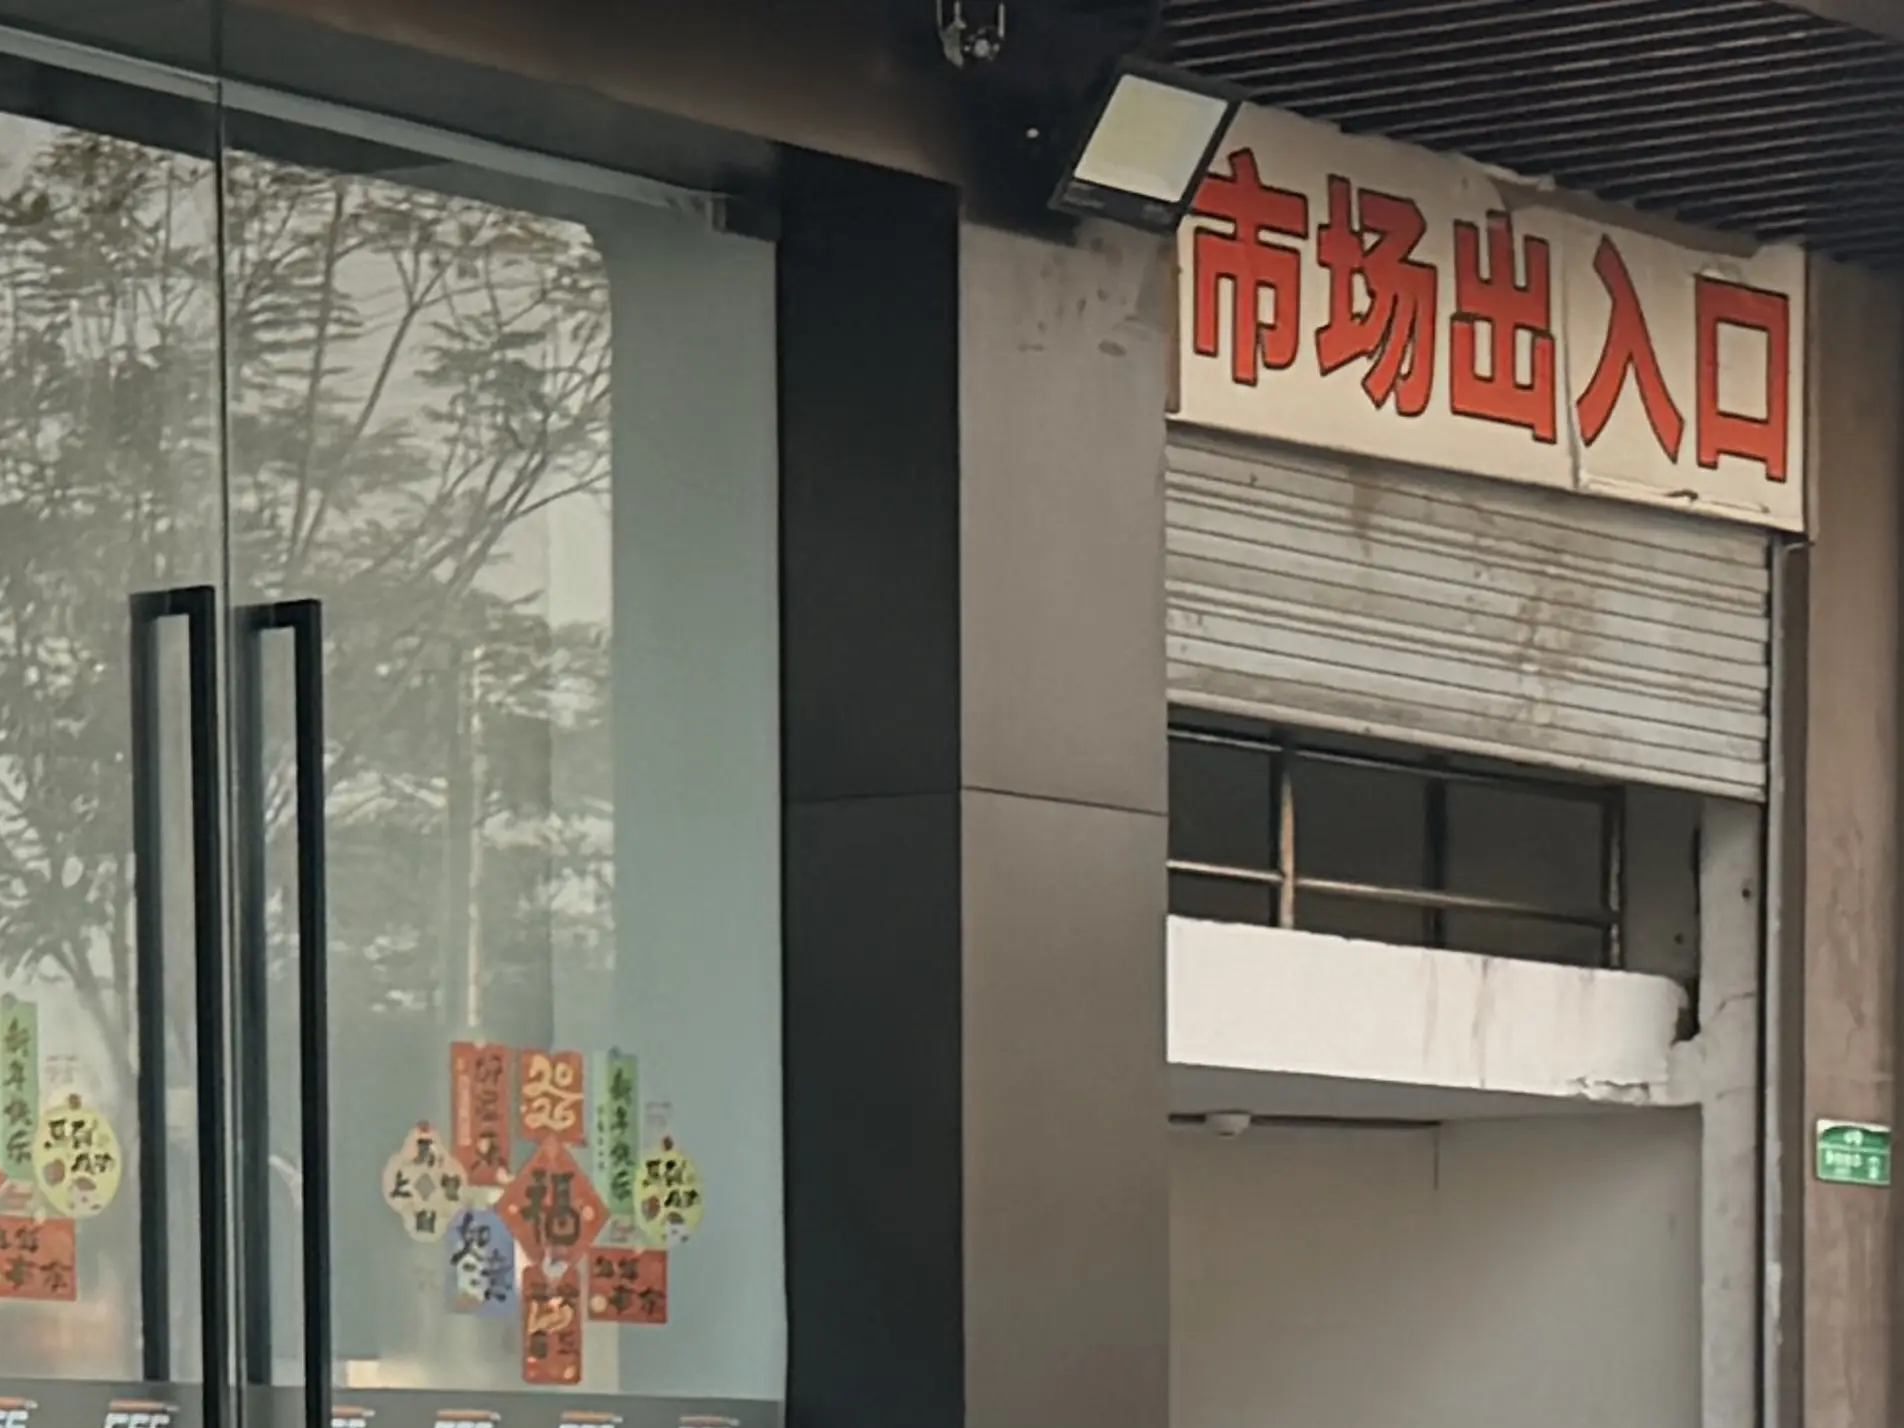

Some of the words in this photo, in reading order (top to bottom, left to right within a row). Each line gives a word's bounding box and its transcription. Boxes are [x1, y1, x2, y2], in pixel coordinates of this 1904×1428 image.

[1191, 148, 1790, 482] 市场出入口
[522, 1169, 580, 1247] 福
